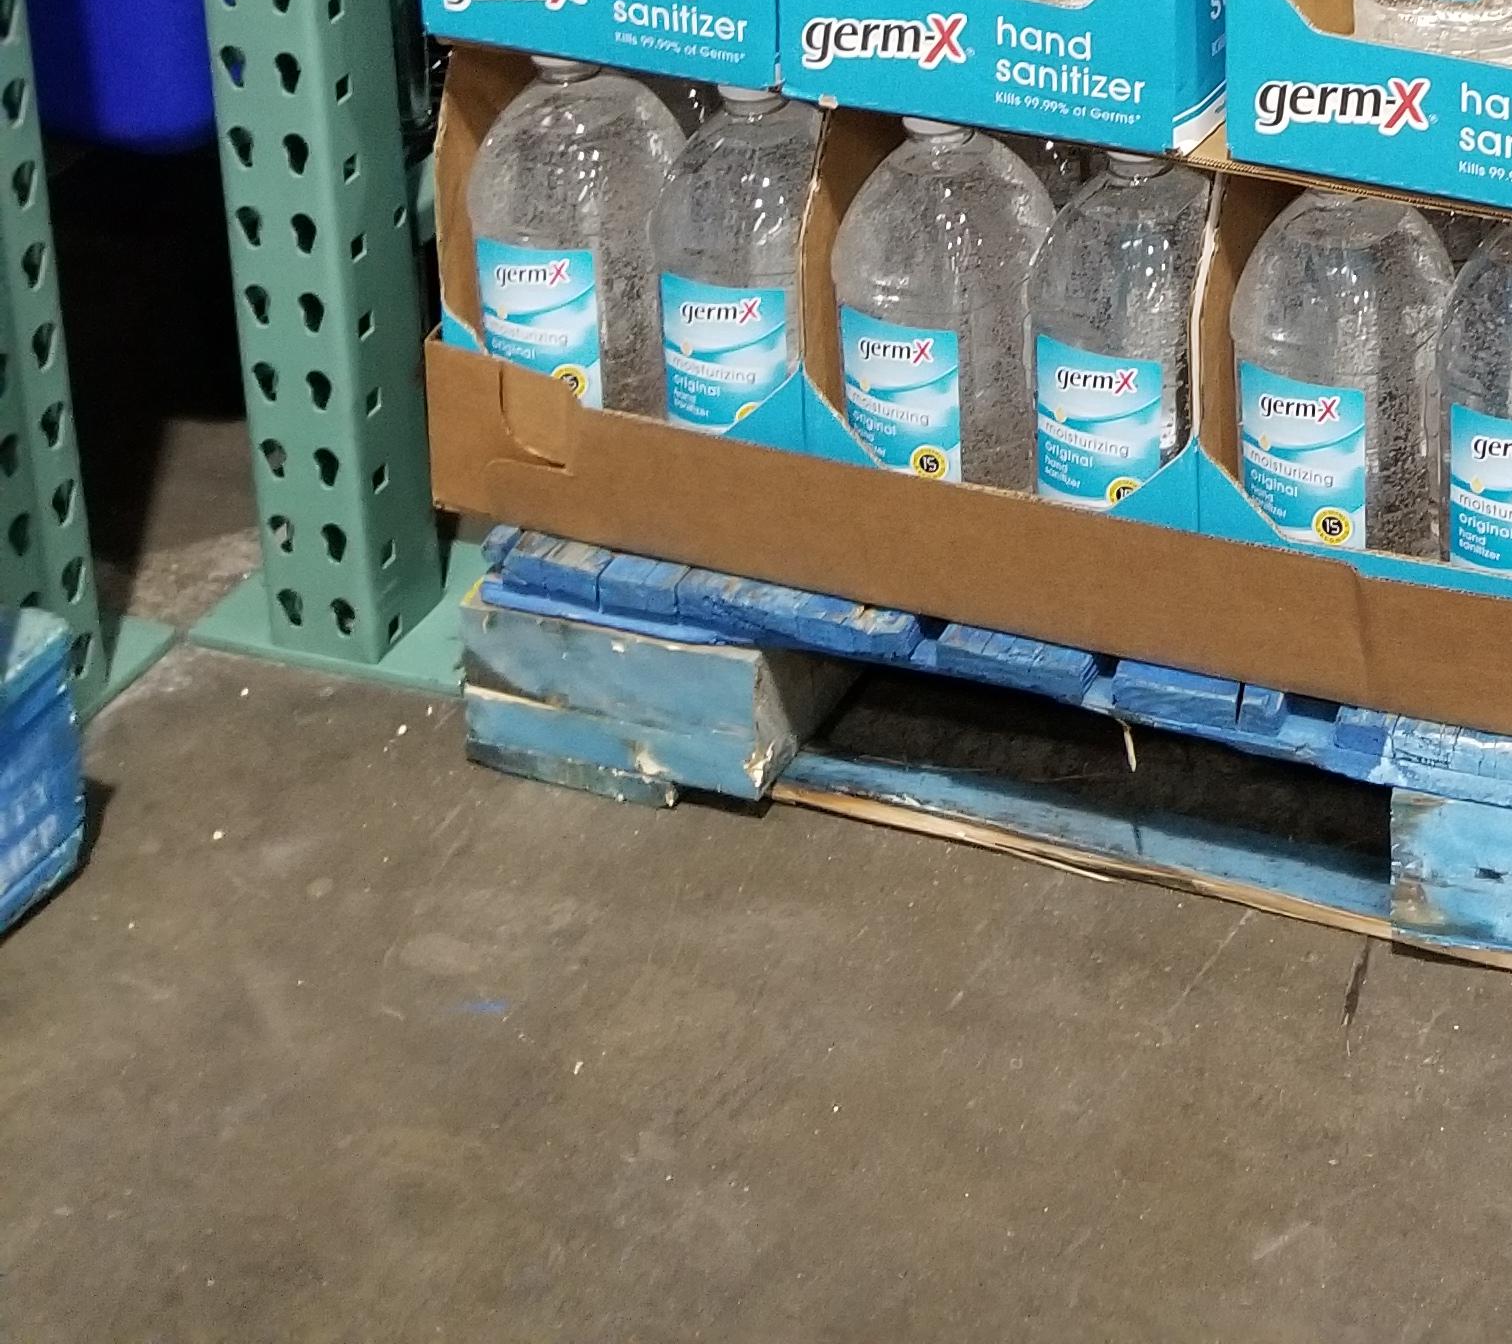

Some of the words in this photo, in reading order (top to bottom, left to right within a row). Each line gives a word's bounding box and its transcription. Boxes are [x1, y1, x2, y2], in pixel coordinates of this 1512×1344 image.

[612, 0, 748, 43] sanitizer
[805, 15, 962, 65] germ-X
[996, 16, 1092, 62] hand
[995, 58, 1147, 105] sanitizer
[995, 91, 1021, 108] Kills
[1024, 95, 1070, 116] 99.99%
[1258, 81, 1426, 130] germ-X
[1459, 160, 1486, 178] Kills
[497, 260, 567, 287] germ-X
[681, 298, 760, 325] germ-X
[859, 338, 933, 364] germ-X
[672, 354, 757, 385] moisturizing
[1056, 367, 1137, 395] germ-X
[673, 373, 721, 398] original
[851, 389, 931, 427] moisturizing
[1260, 395, 1338, 423] germ-X
[852, 409, 896, 437] original
[1044, 420, 1130, 458] moisturizing
[920, 455, 938, 473] 15
[1044, 440, 1093, 470] original
[1250, 448, 1335, 489] moisturizing
[1250, 469, 1299, 498] original
[1323, 517, 1341, 535] 15
